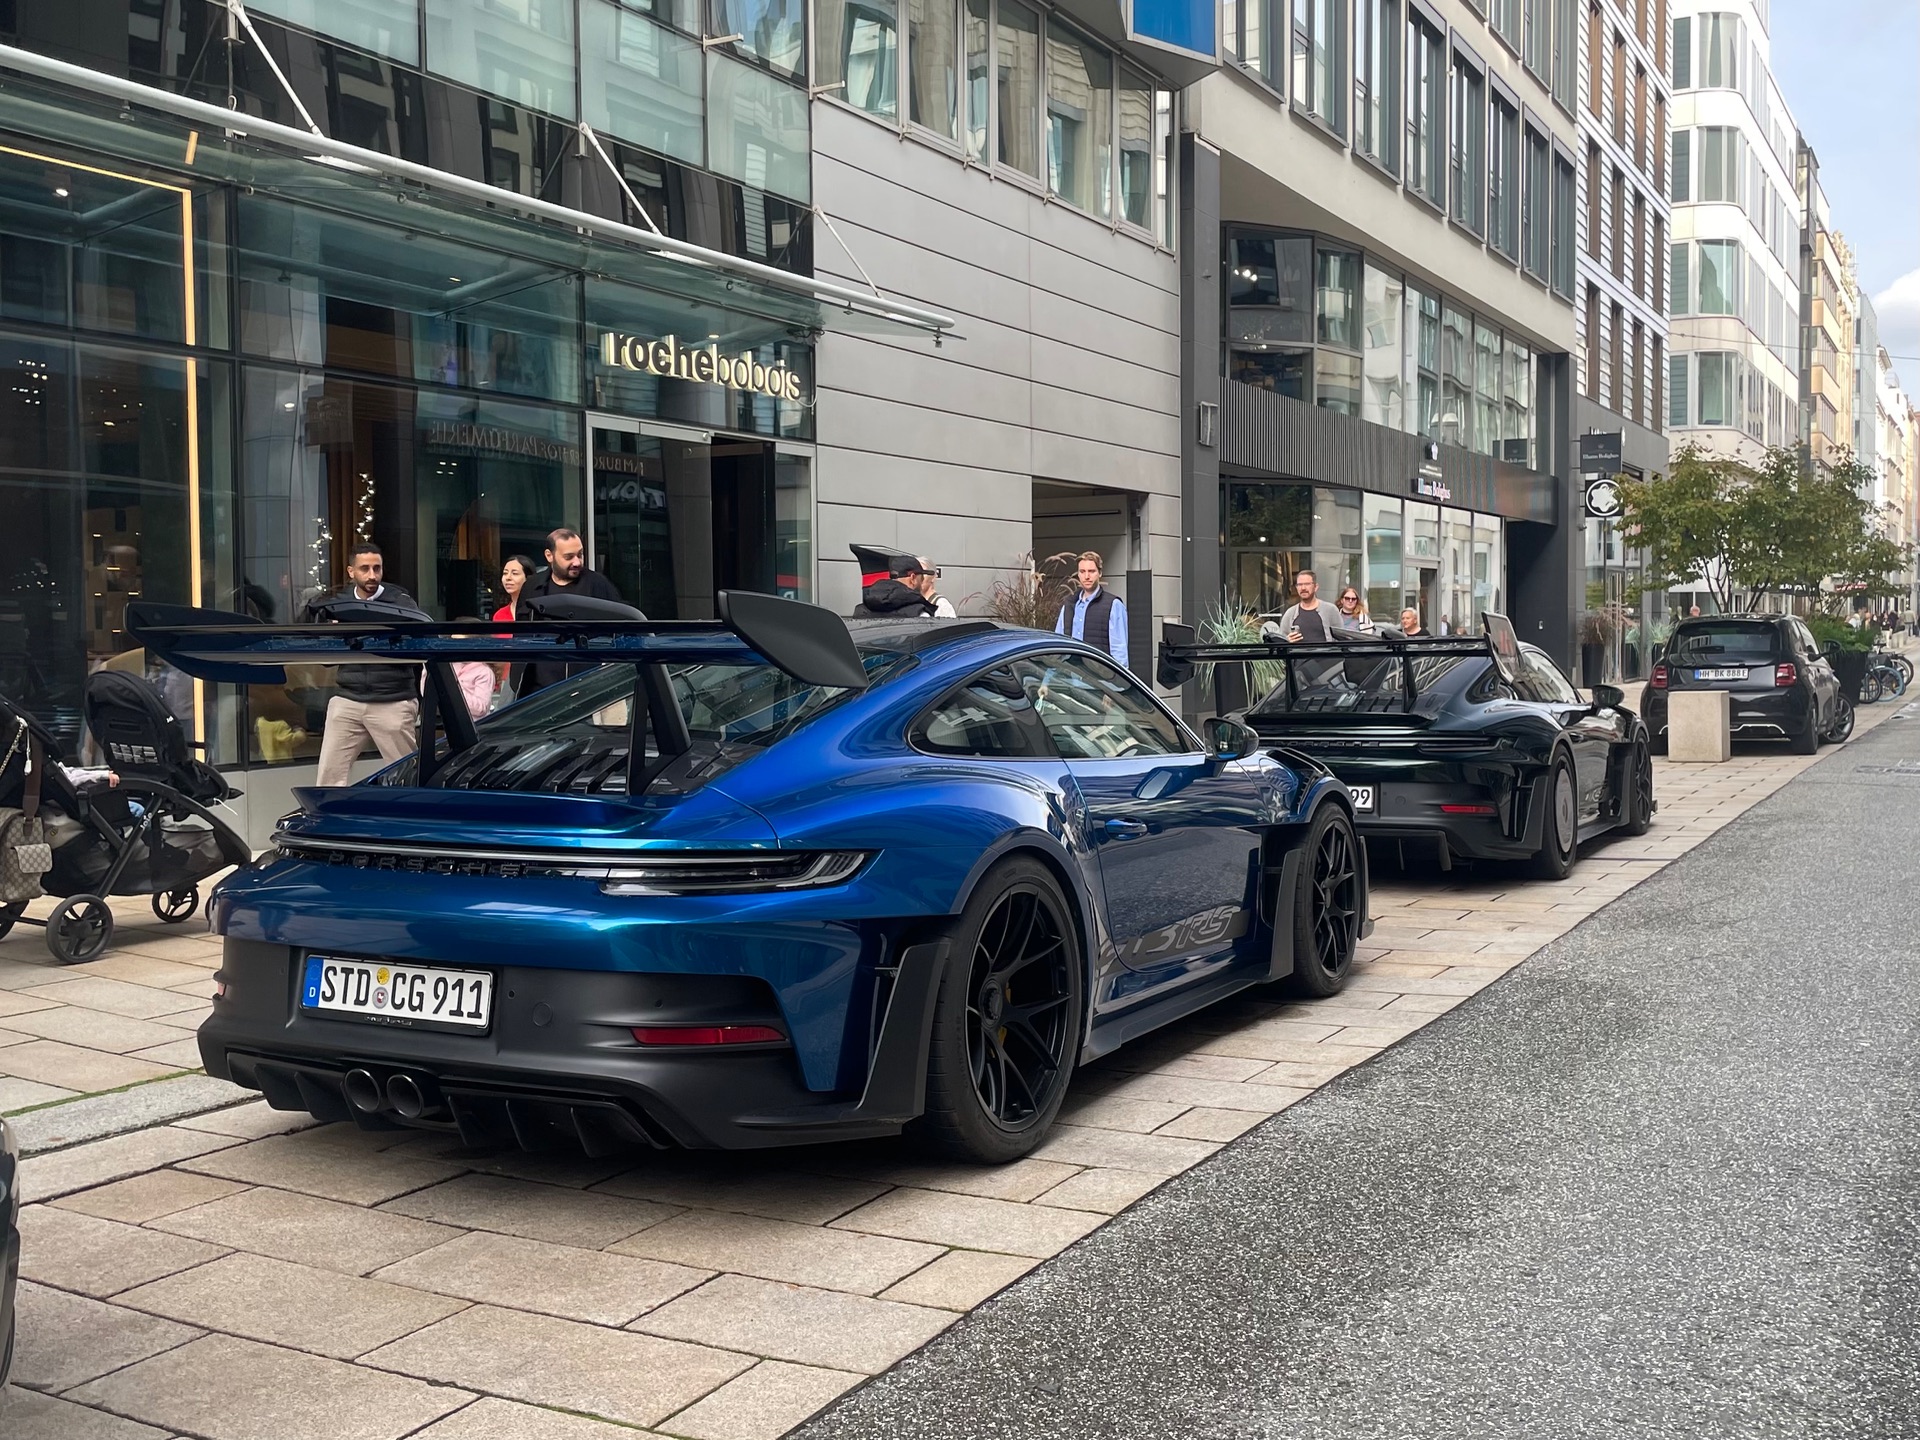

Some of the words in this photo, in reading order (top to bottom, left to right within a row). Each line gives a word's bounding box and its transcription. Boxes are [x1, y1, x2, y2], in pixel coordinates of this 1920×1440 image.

[601, 332, 800, 401] rochebobois
[1699, 669, 1709, 678] HH
[309, 987, 316, 998] D
[321, 965, 371, 1006] STD
[390, 972, 427, 1012] CG
[432, 976, 483, 1019] 911
